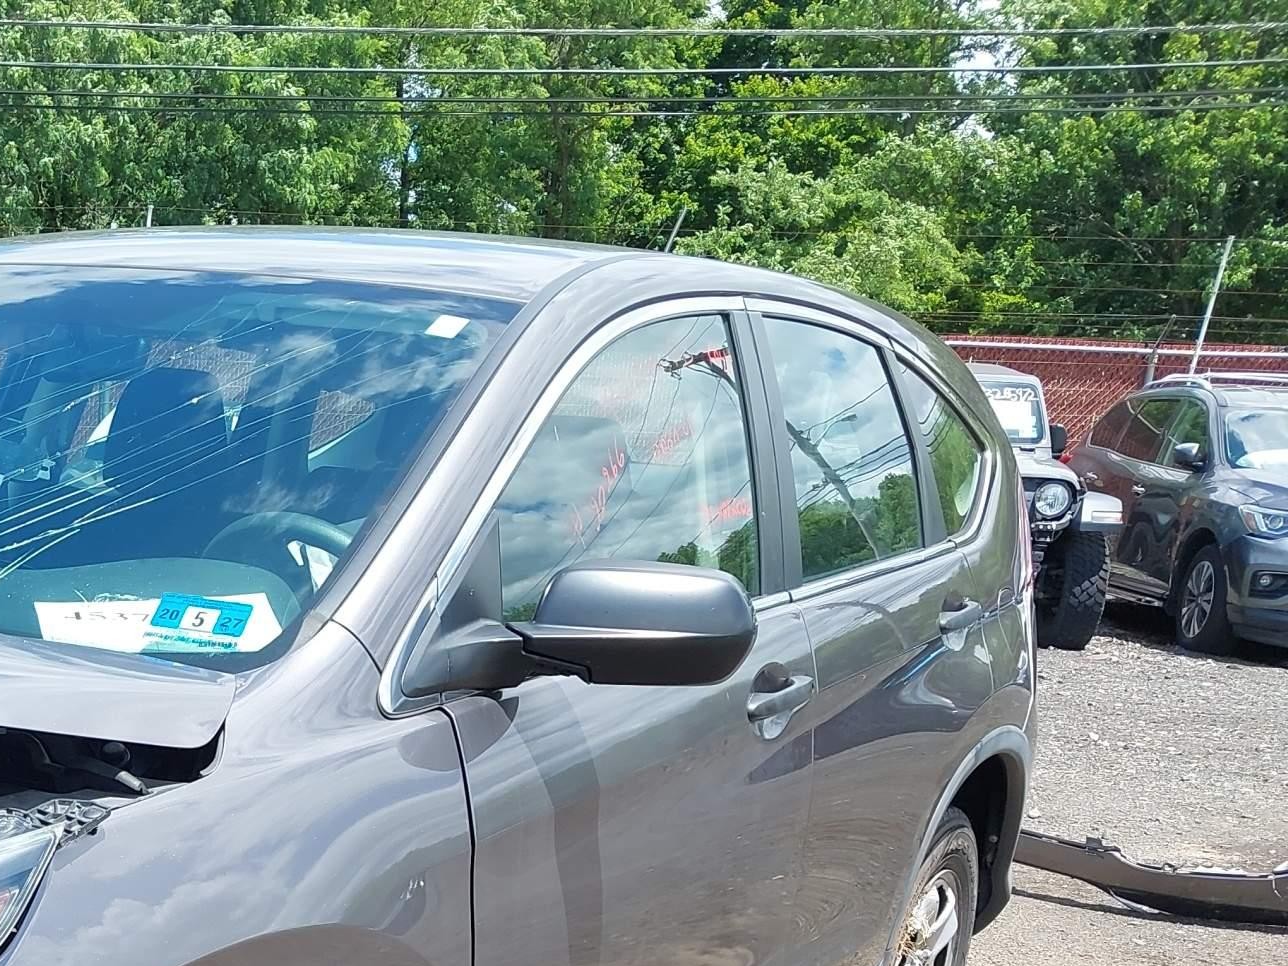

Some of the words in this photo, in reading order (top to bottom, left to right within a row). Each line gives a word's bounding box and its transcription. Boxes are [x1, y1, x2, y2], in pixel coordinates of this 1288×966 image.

[158, 607, 180, 621] 20
[192, 611, 208, 628] 5
[219, 616, 244, 629] 27
